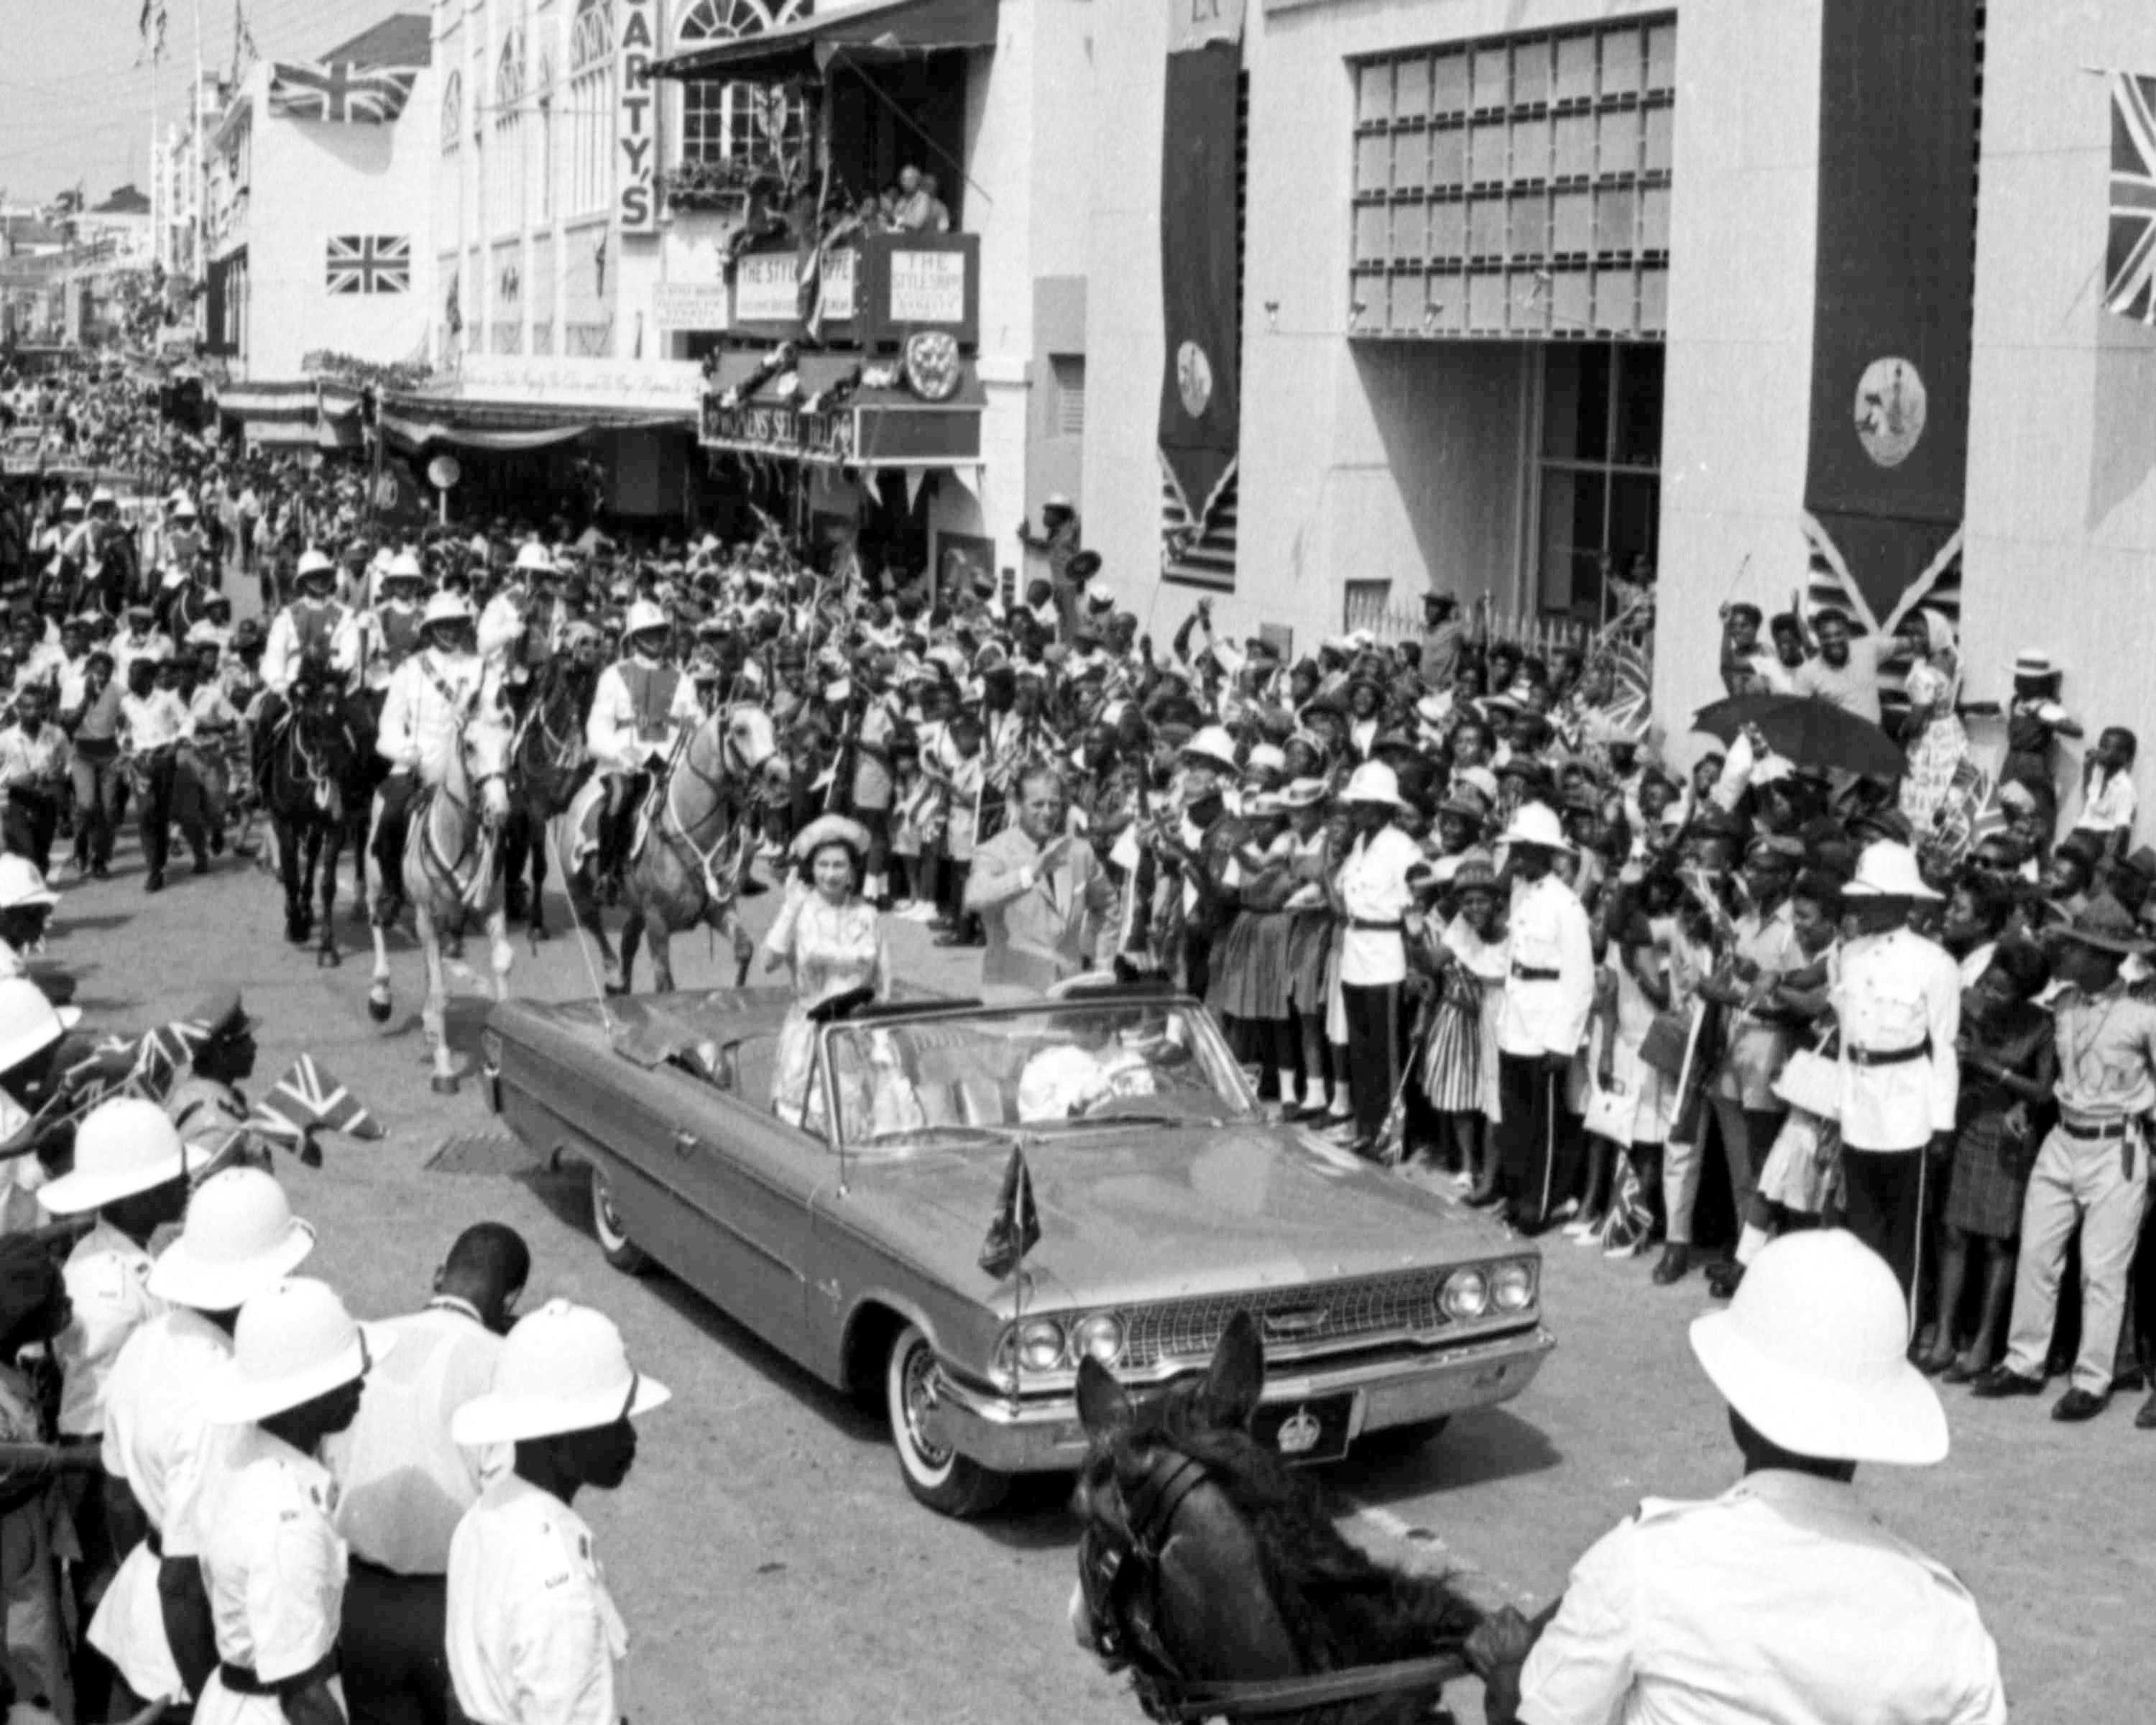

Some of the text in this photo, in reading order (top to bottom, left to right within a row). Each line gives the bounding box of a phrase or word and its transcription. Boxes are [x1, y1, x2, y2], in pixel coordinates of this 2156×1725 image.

[620, 0, 652, 226] ARTY'S
[740, 259, 762, 283] THE
[765, 257, 797, 284] STYL
[908, 252, 948, 271] THE
